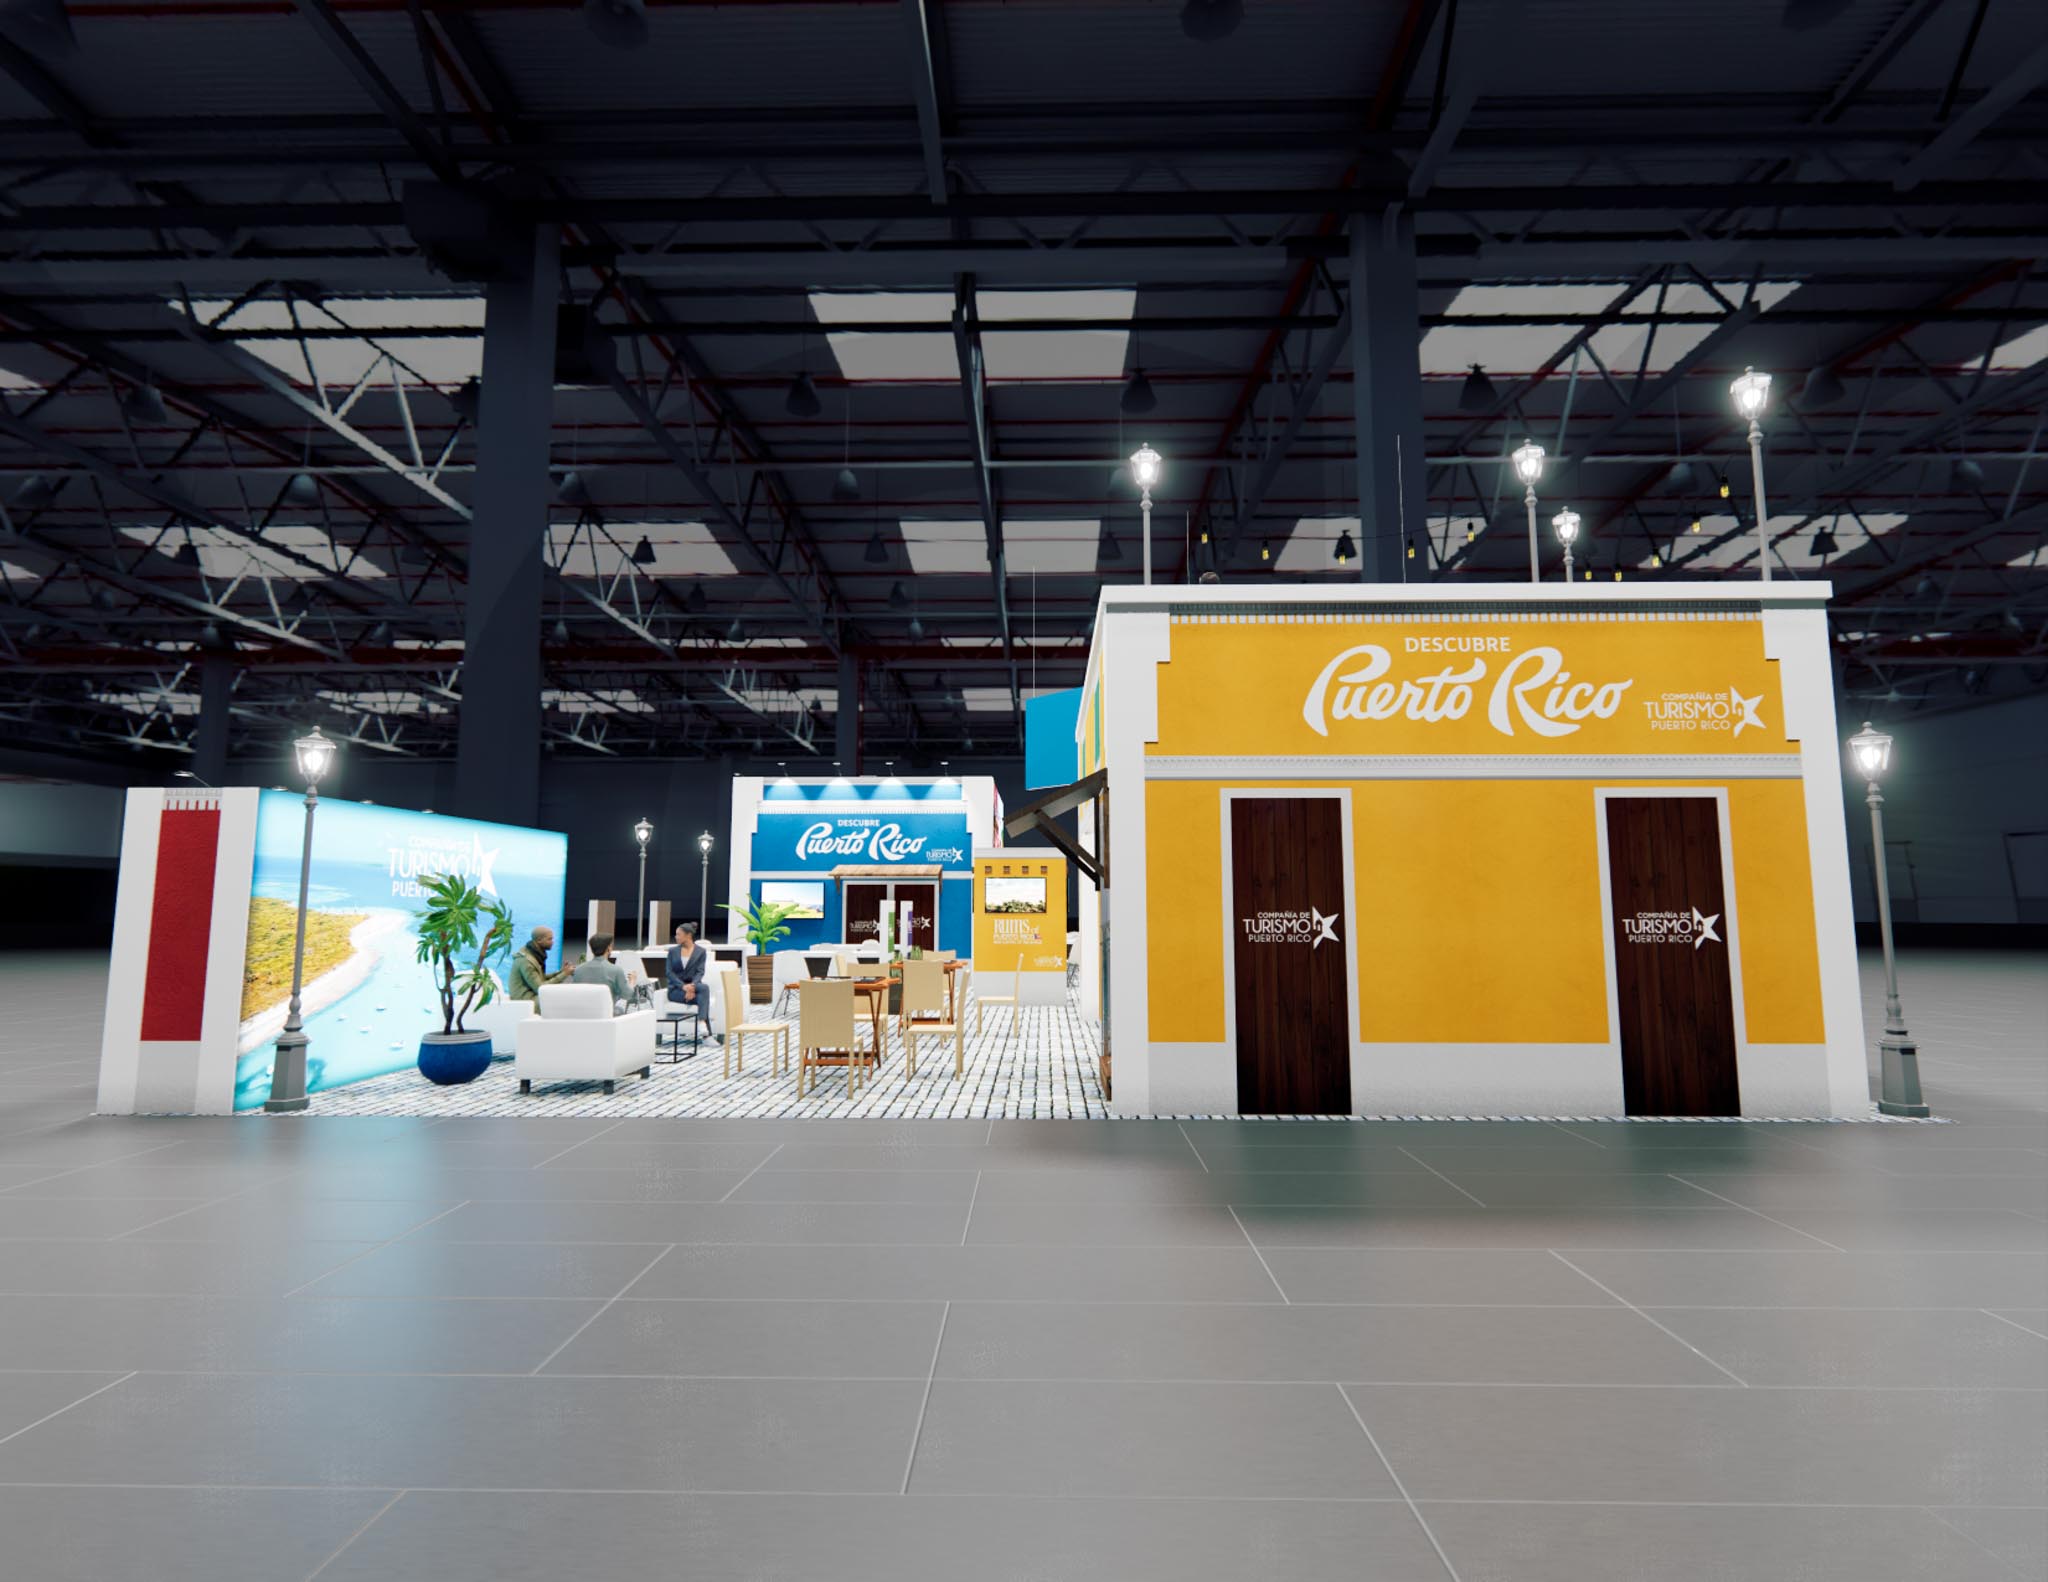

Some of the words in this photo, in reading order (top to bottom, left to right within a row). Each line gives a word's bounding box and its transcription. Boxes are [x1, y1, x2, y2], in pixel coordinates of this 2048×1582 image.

[1404, 636, 1511, 653] DESCUBRE
[1302, 644, 1487, 737] Puerto
[1488, 646, 1634, 737] Rico
[1714, 692, 1729, 701] DE
[1643, 701, 1730, 719] TURISMO
[1651, 720, 1697, 730] PUERTO
[1700, 720, 1731, 730] RICO
[837, 819, 880, 827] DESCUBRE
[796, 822, 871, 860] Puerto
[868, 823, 928, 861] Rico
[388, 847, 471, 881] TURISMO
[1299, 911, 1311, 919] DE
[1679, 911, 1691, 919] DE
[1242, 918, 1311, 934] TURISMO
[1622, 918, 1692, 934] TURISMO
[1248, 934, 1285, 943] PUERTO
[1286, 934, 1312, 943] RICO
[1628, 934, 1666, 943] PUERTO
[1667, 934, 1693, 943] RICO
